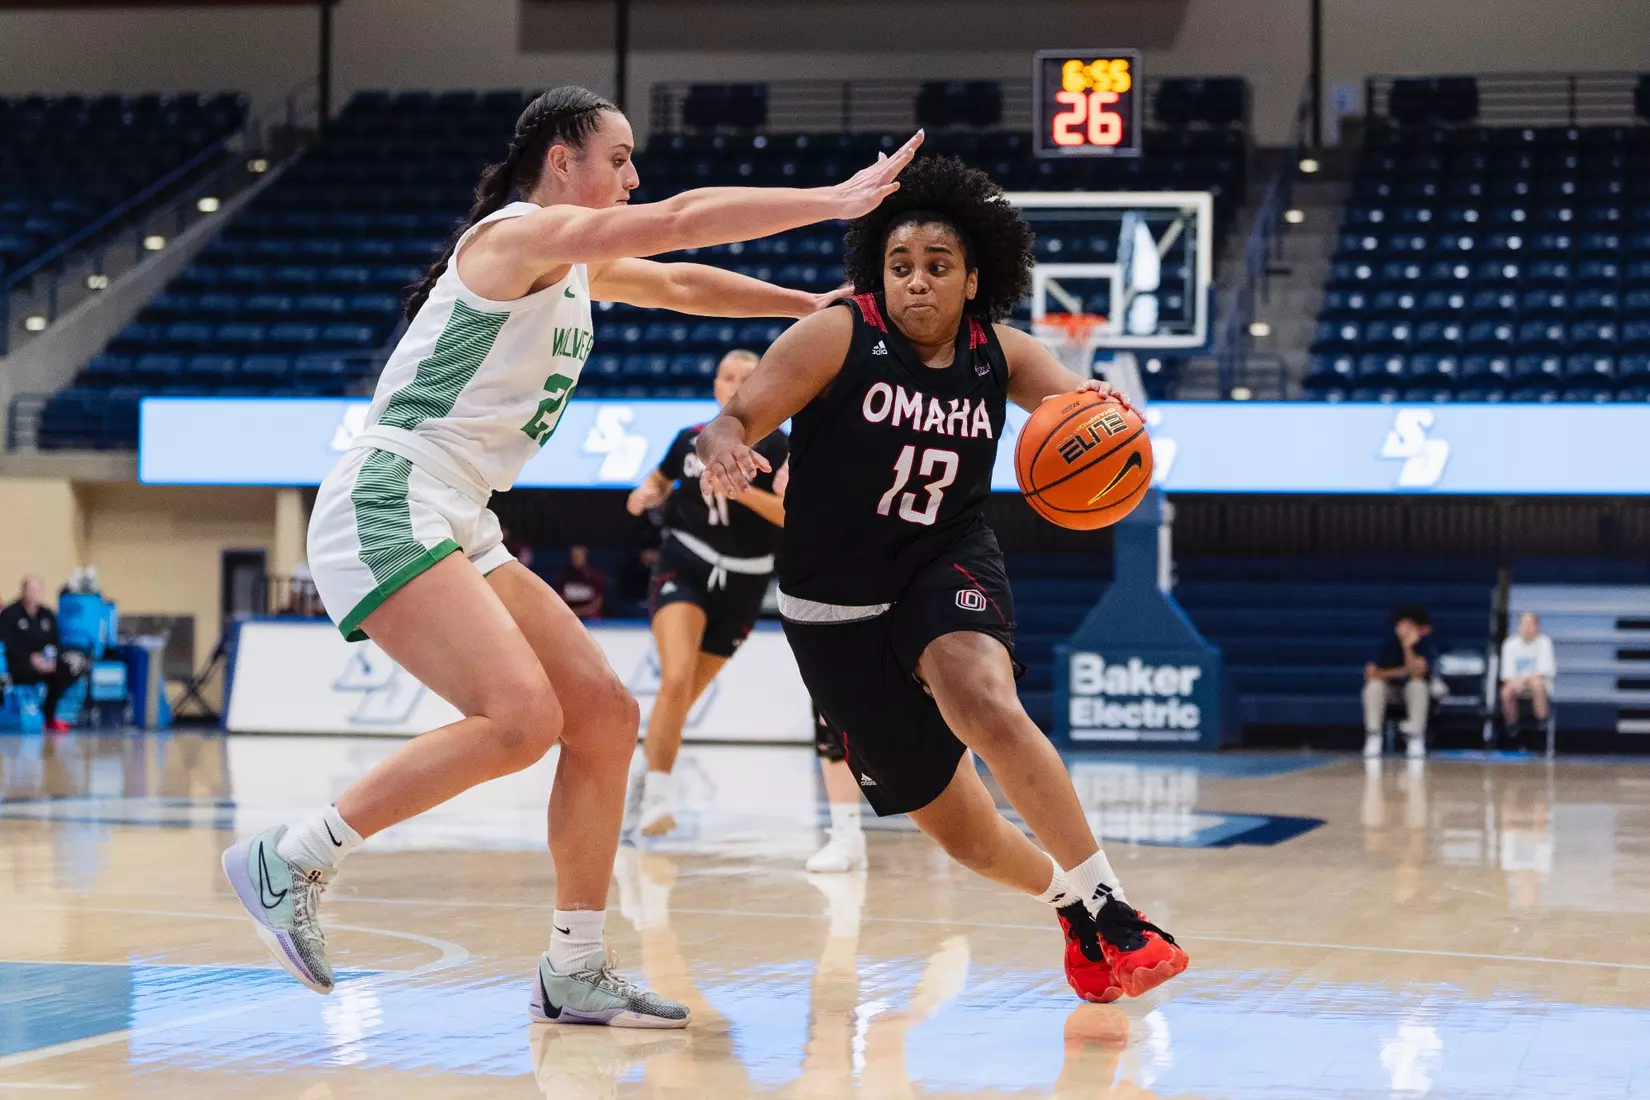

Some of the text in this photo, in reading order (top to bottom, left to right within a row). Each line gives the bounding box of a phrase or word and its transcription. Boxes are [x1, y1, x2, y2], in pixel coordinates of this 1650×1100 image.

[1053, 91, 1122, 146] 26
[519, 372, 576, 448] 2
[862, 382, 993, 439] OMAHA
[1058, 412, 1128, 464] ELITE
[876, 445, 959, 526] 13
[1070, 652, 1201, 696] Baker
[1070, 698, 1200, 728] Electric
